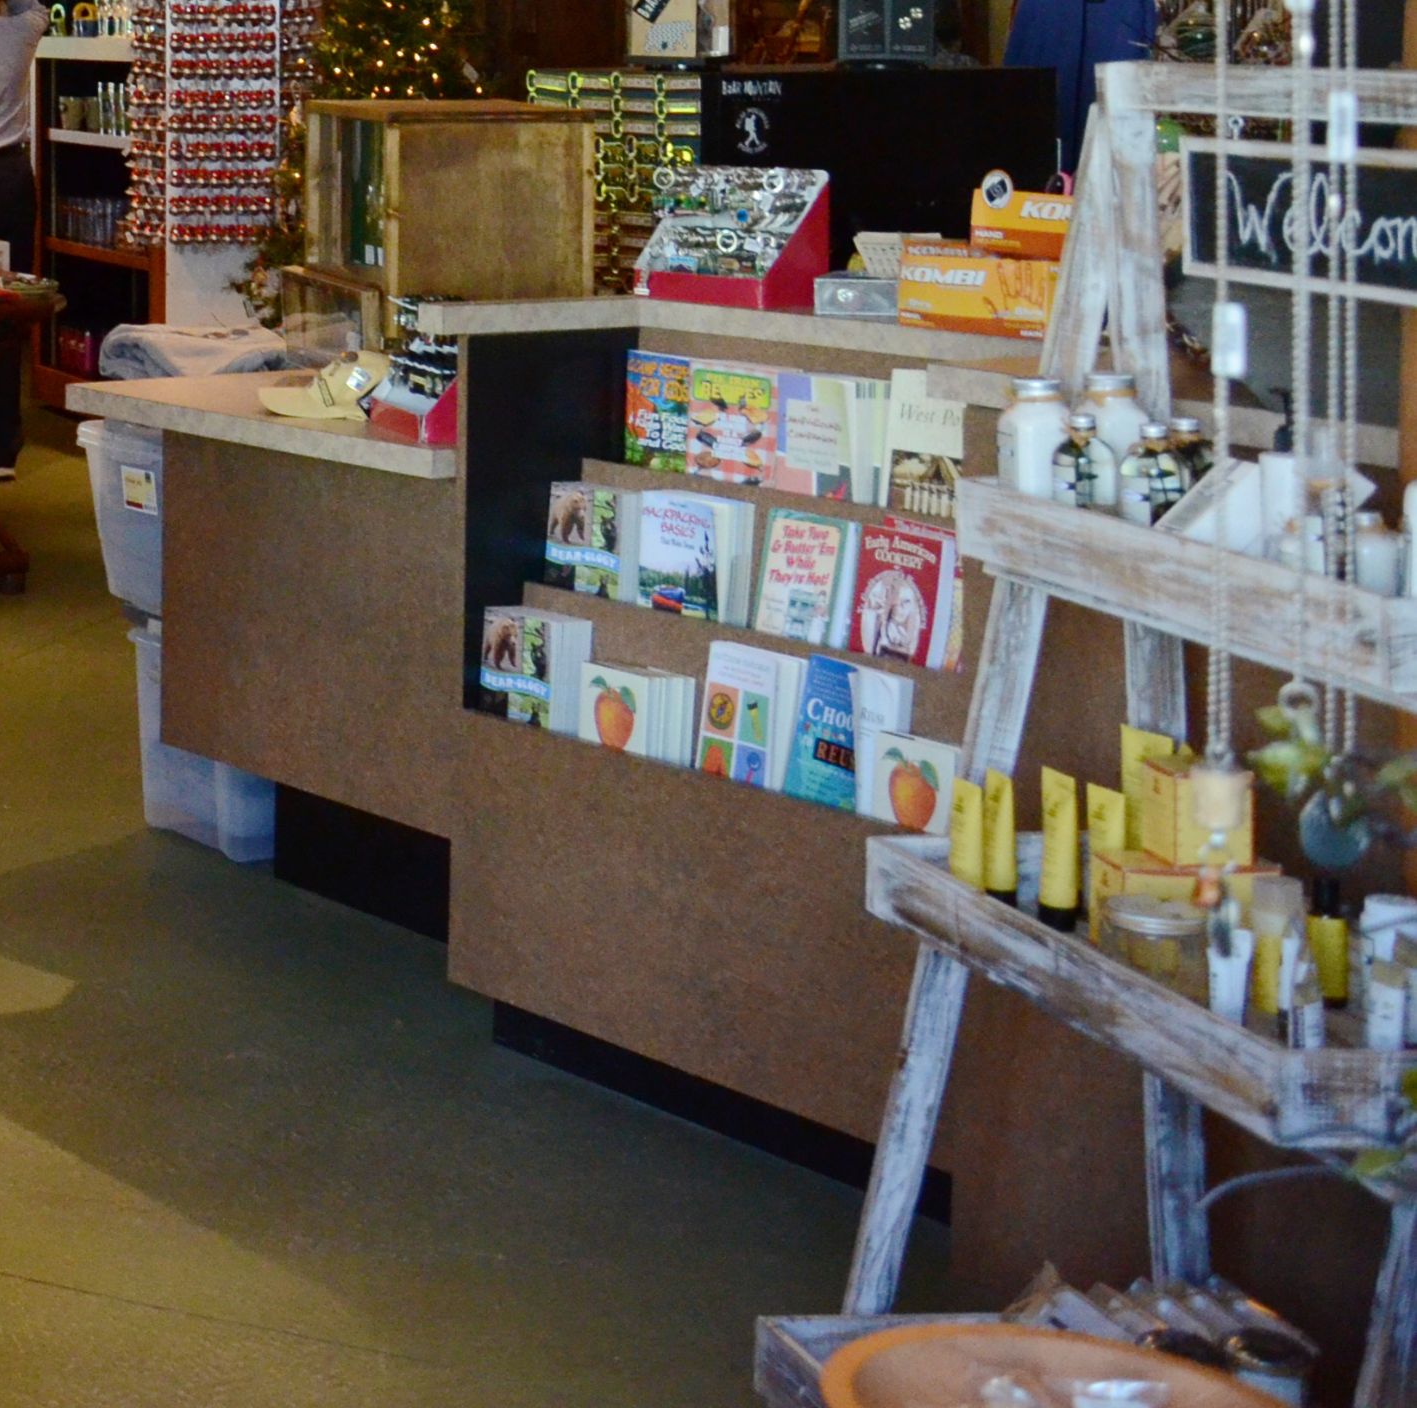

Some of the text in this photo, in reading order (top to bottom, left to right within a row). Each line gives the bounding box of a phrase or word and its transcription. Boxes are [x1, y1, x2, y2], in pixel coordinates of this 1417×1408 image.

[901, 266, 987, 286] KOMBI
[900, 403, 937, 423] West
[783, 525, 830, 539] Take Two
[784, 539, 815, 554] Butter
